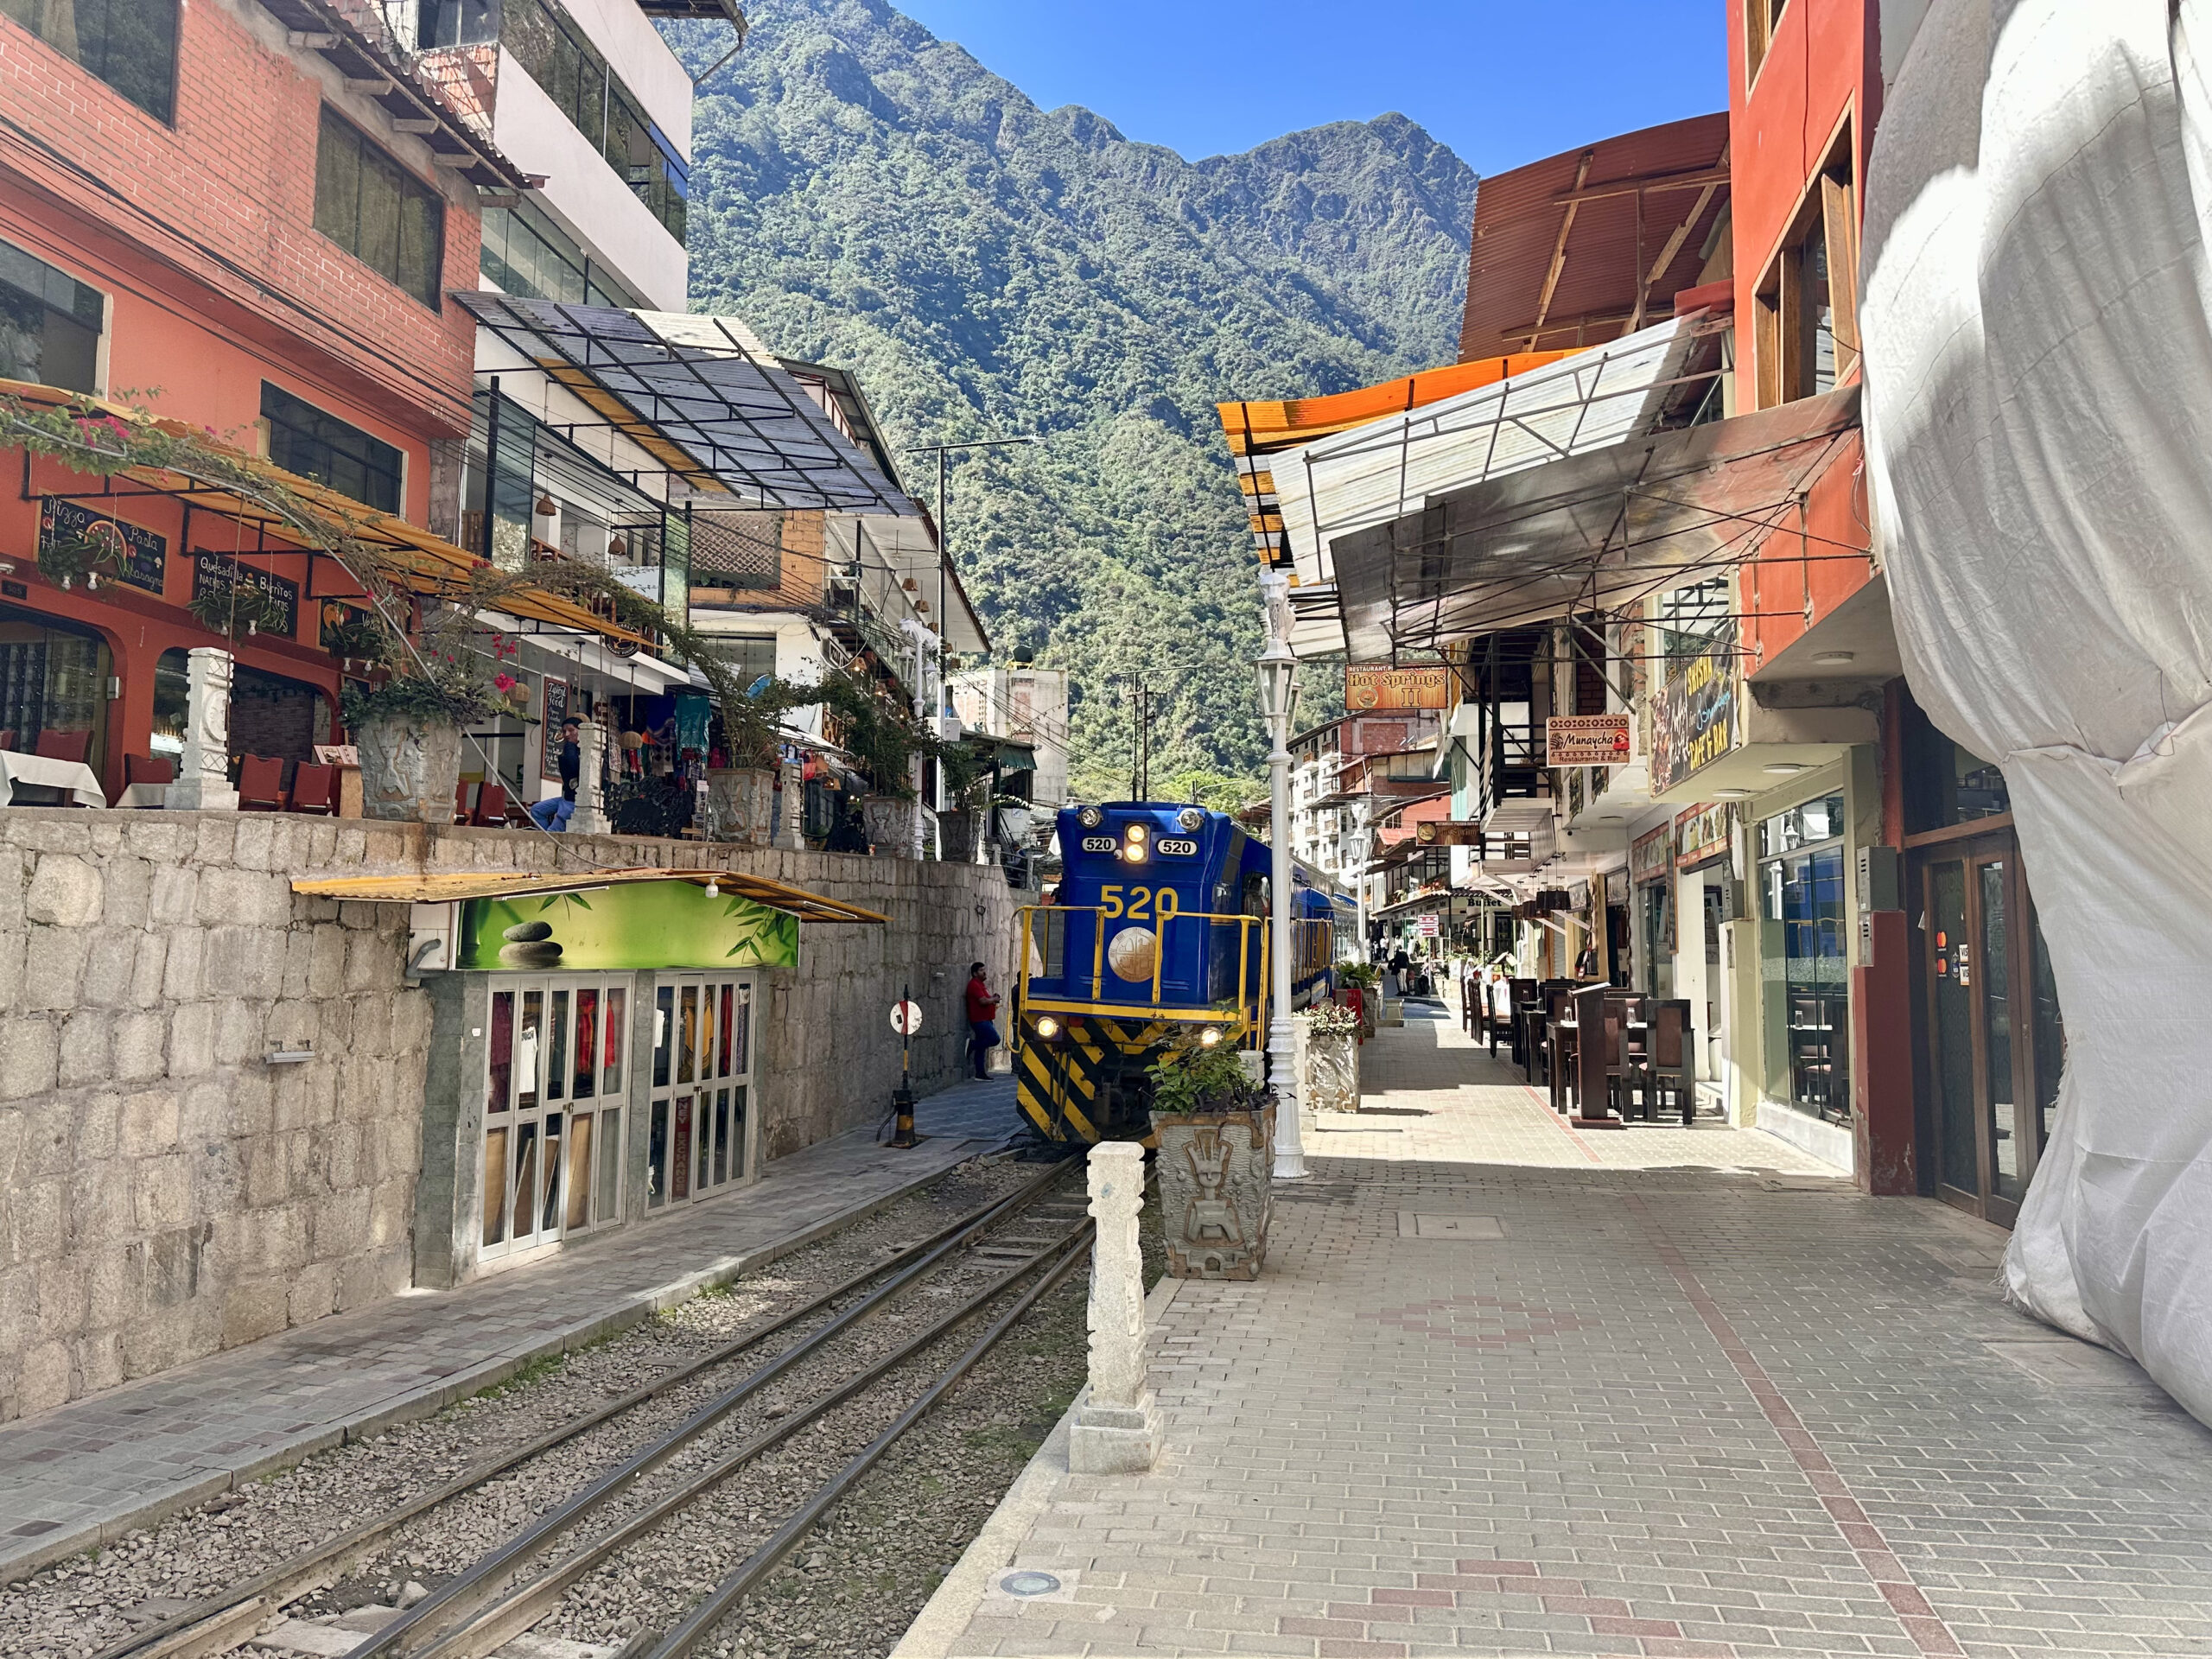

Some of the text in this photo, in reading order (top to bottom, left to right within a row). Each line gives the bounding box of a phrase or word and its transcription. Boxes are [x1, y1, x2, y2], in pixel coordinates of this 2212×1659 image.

[129, 525, 158, 551] Pasta
[1348, 671, 1445, 688] Hot Springs
[1687, 648, 1713, 696] SHISHA
[1401, 688, 1421, 707] II
[1563, 731, 1613, 750] Munaycha
[1690, 733, 1707, 772] CAFE
[1713, 718, 1727, 756] BAR
[1086, 839, 1111, 850] 520
[1163, 842, 1191, 853] 520
[1101, 885, 1179, 920] 520
[676, 1131, 687, 1191] EXCHANGE
